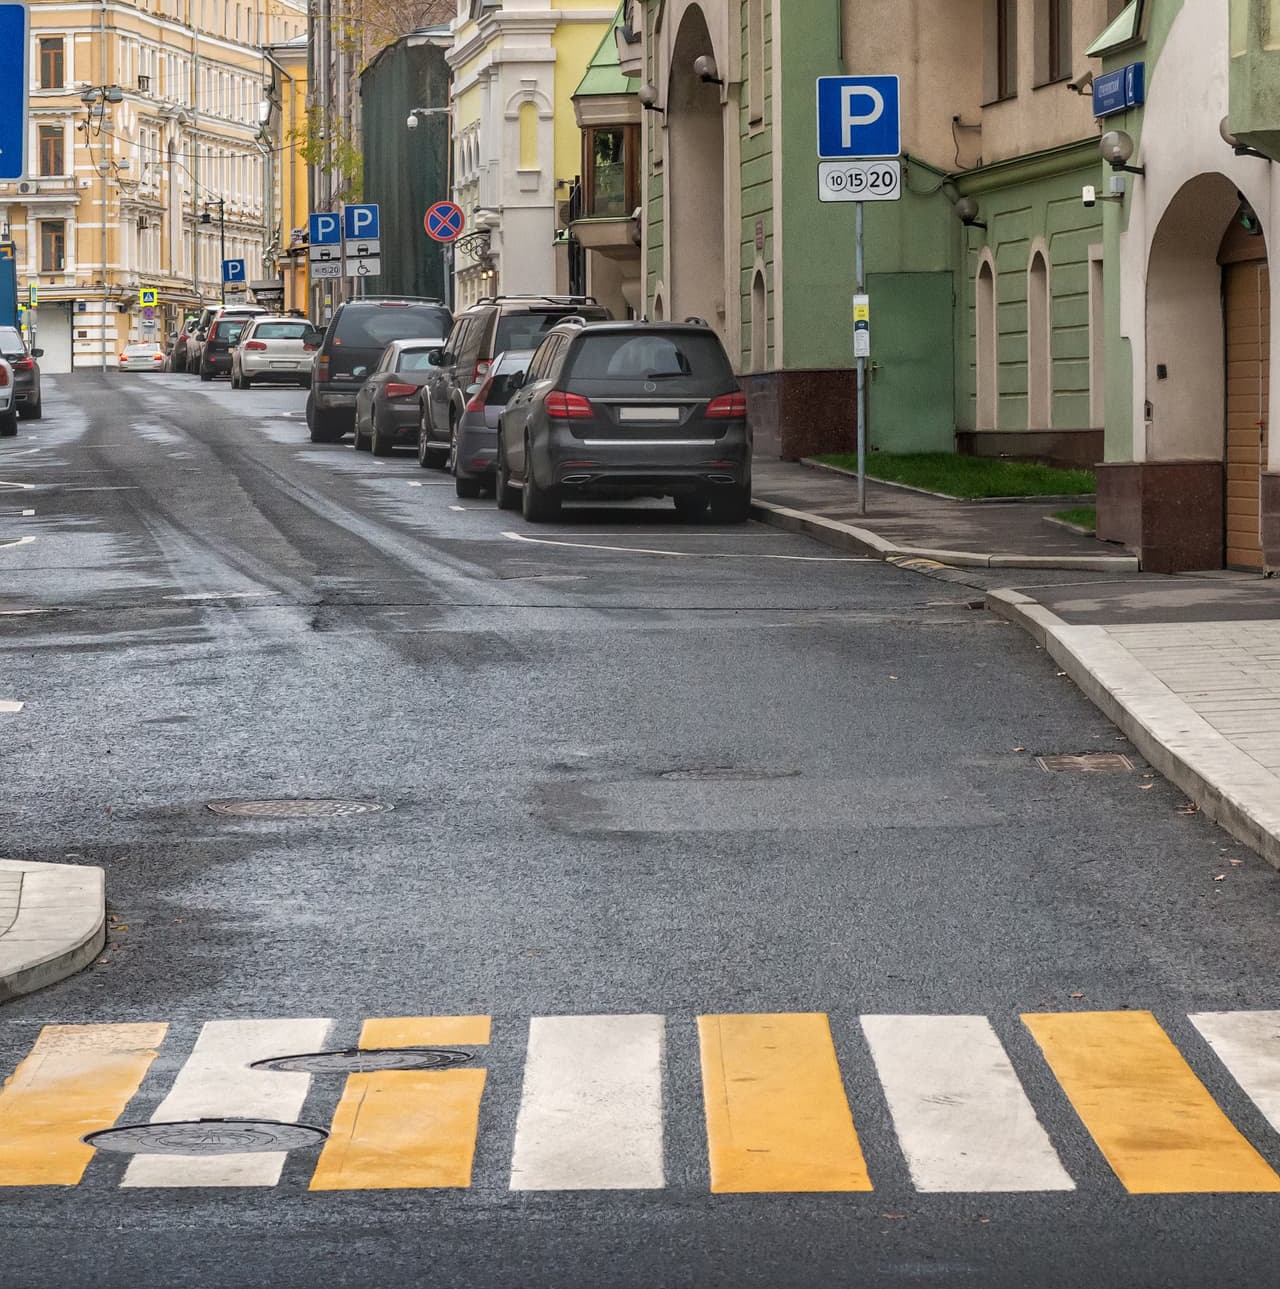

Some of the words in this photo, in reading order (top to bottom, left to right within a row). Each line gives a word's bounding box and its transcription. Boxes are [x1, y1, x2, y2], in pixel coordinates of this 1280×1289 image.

[841, 85, 885, 148] P
[830, 175, 843, 187] 10
[847, 173, 863, 188] 15
[869, 171, 894, 188] 20
[317, 216, 336, 241] P
[353, 208, 373, 236] P
[228, 262, 241, 280] P
